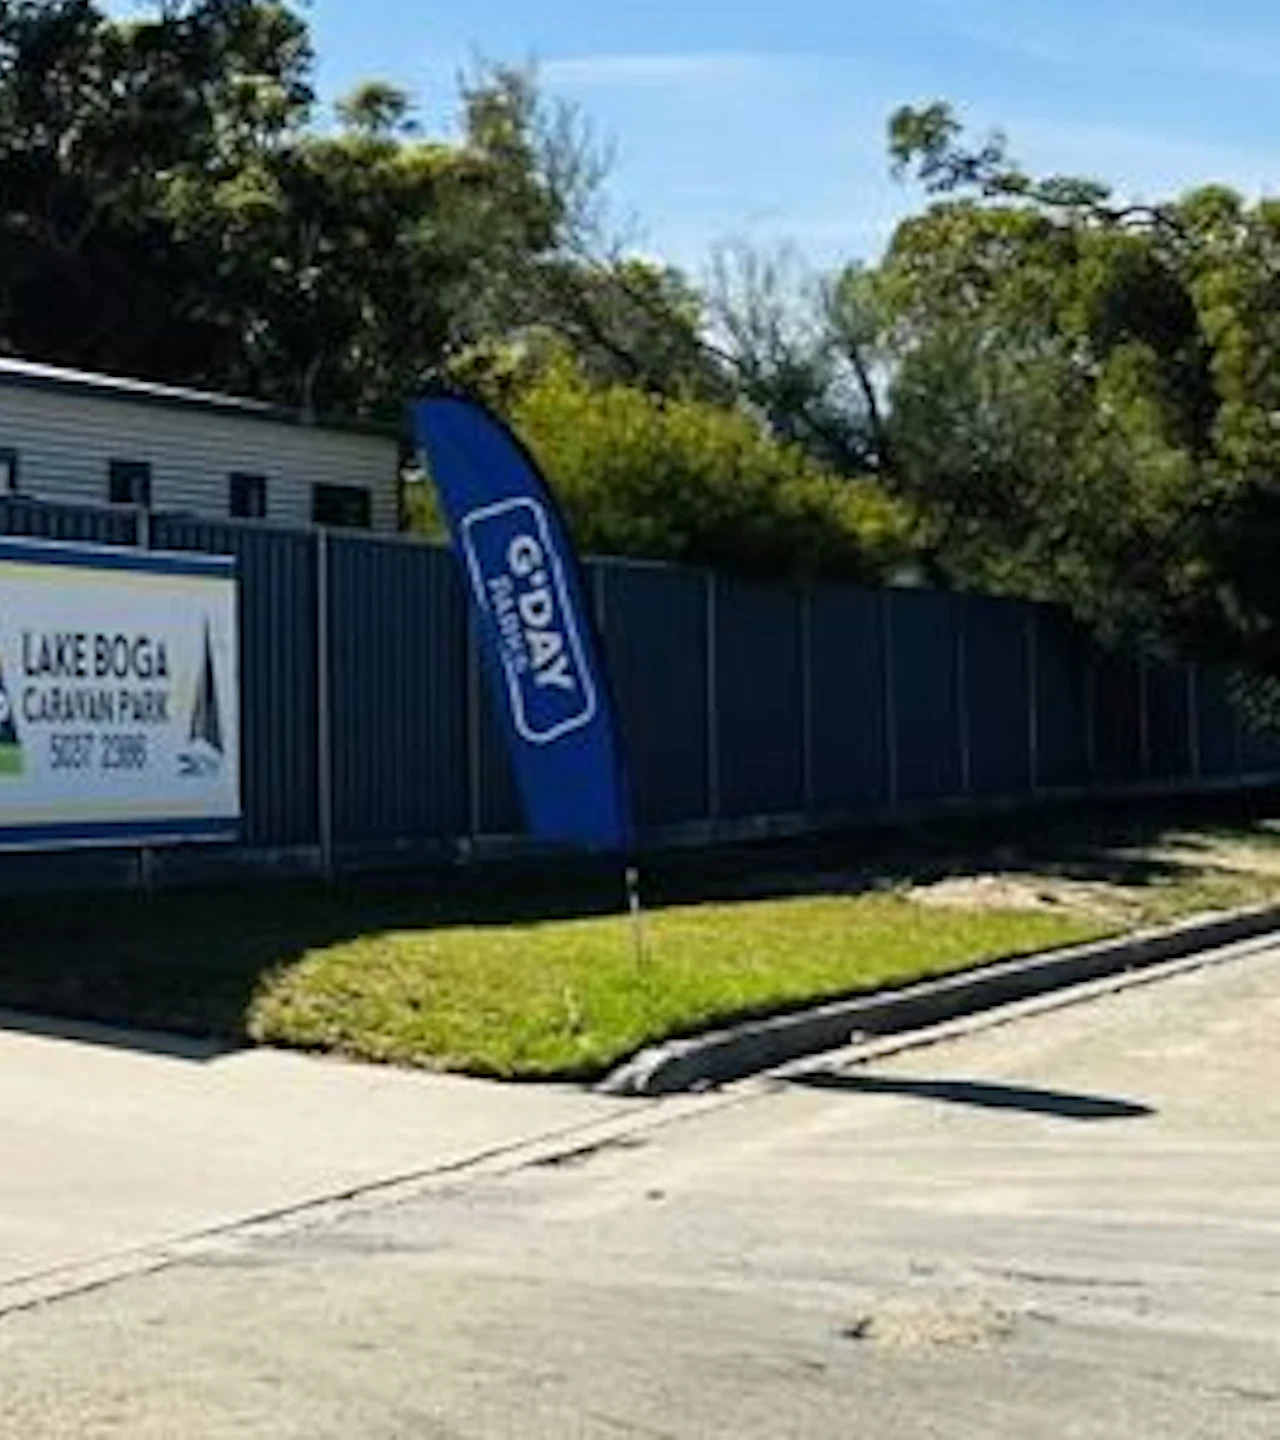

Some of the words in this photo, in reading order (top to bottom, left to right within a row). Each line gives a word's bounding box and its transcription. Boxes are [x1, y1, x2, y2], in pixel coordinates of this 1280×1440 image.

[507, 534, 575, 690] G'DAY
[22, 633, 88, 676] LAKE
[94, 634, 170, 679] BOGA
[22, 686, 114, 723] CARAVAN
[118, 690, 170, 723] PARK
